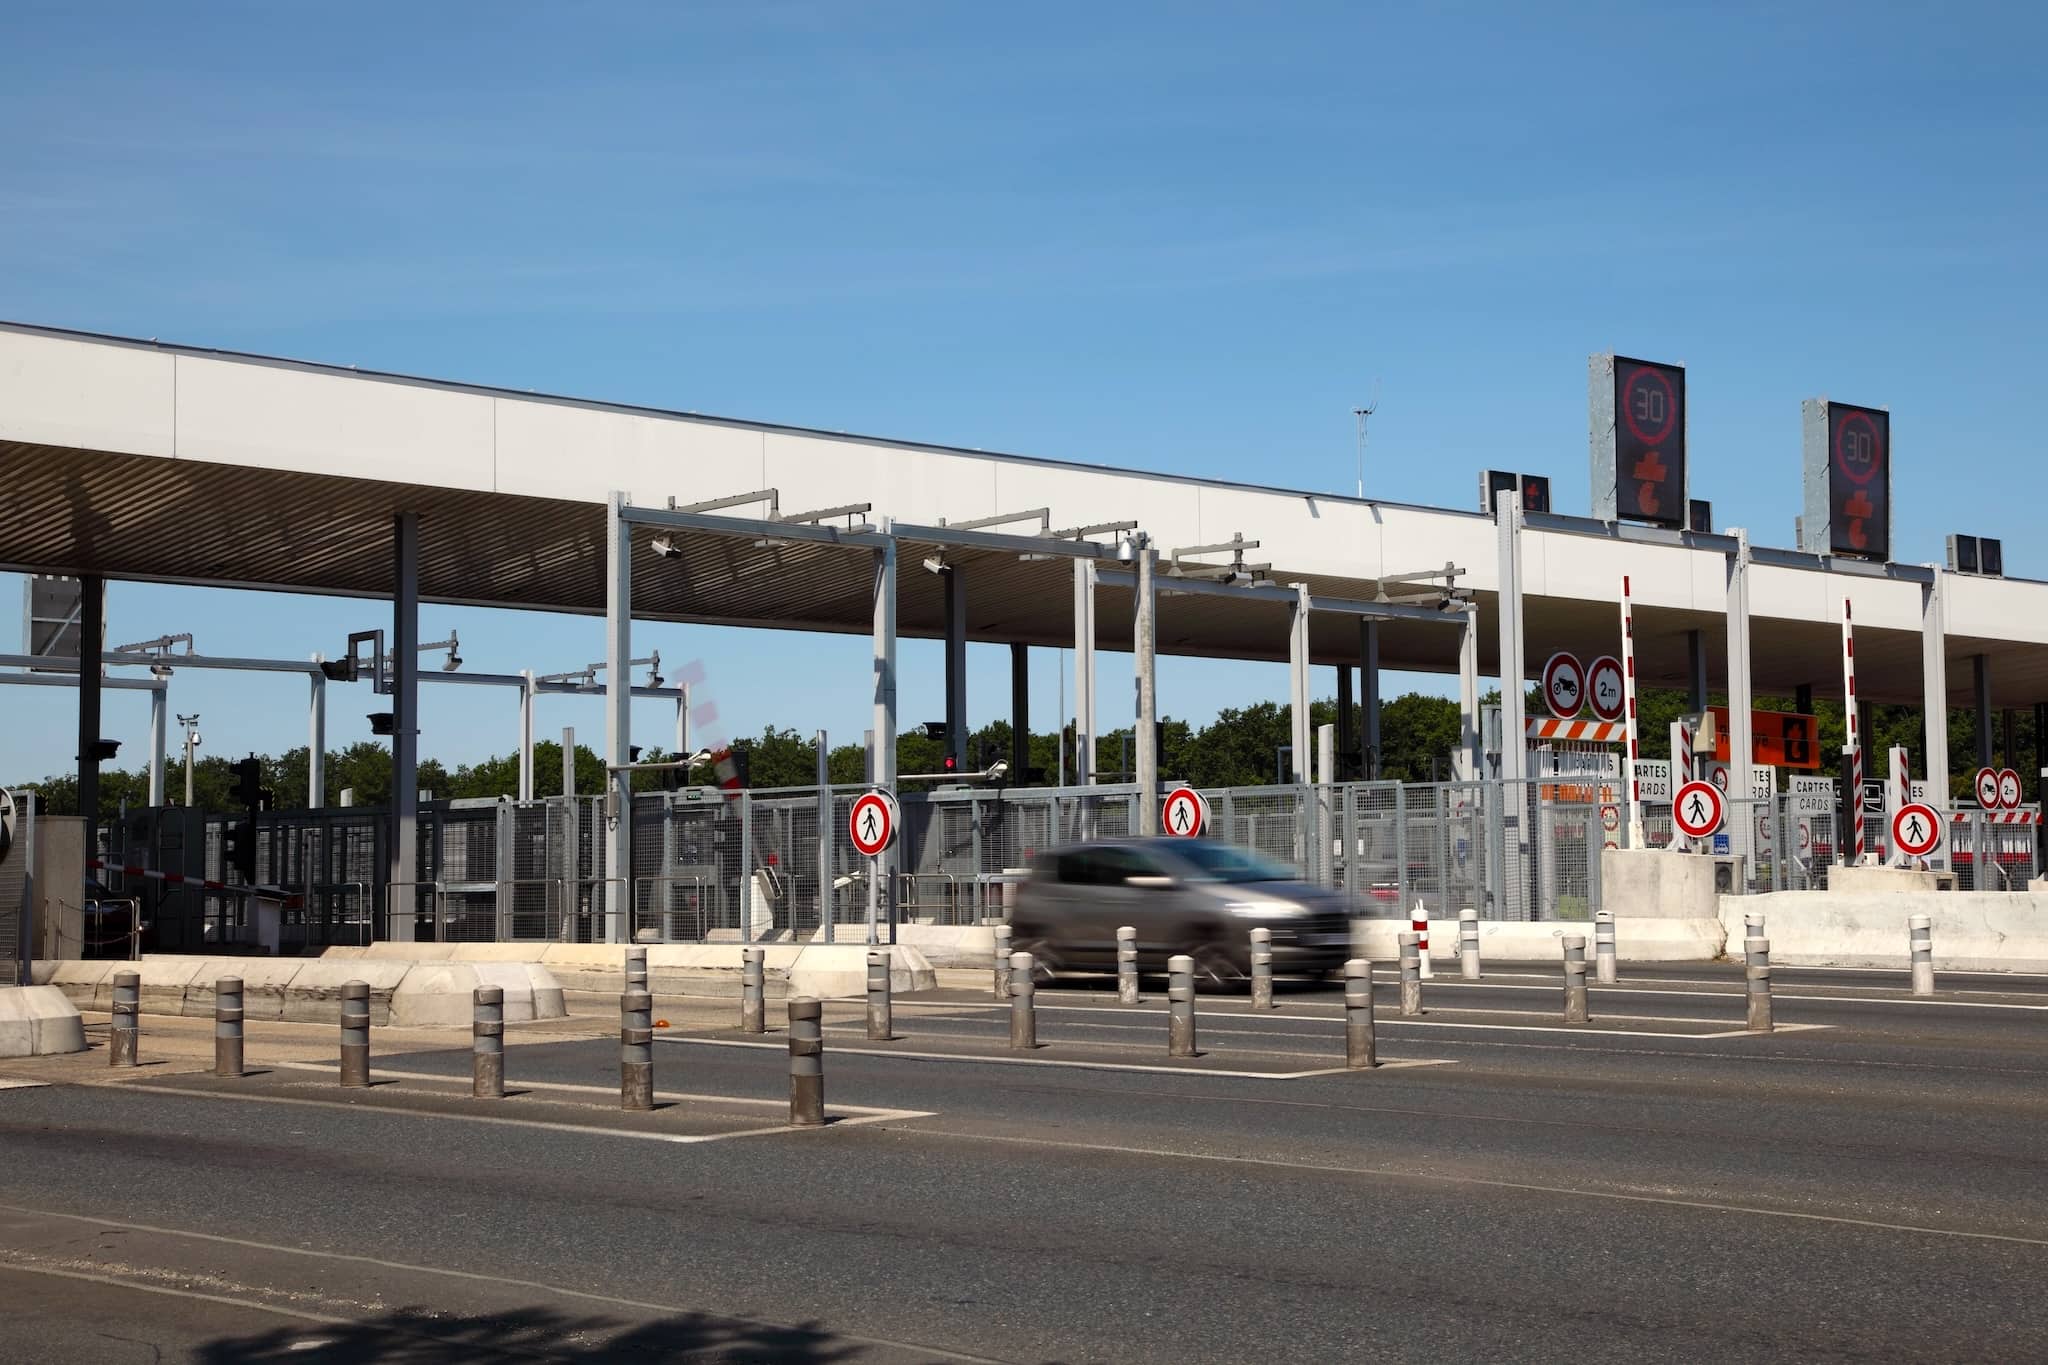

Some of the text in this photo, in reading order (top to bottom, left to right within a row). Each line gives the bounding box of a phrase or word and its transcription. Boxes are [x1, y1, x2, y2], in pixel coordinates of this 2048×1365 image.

[1636, 387, 1664, 422] 30
[1847, 431, 1871, 463] 30
[1635, 765, 1667, 778] ARTES
[1640, 782, 1666, 796] ARDS
[1800, 798, 1830, 811] CARDS
